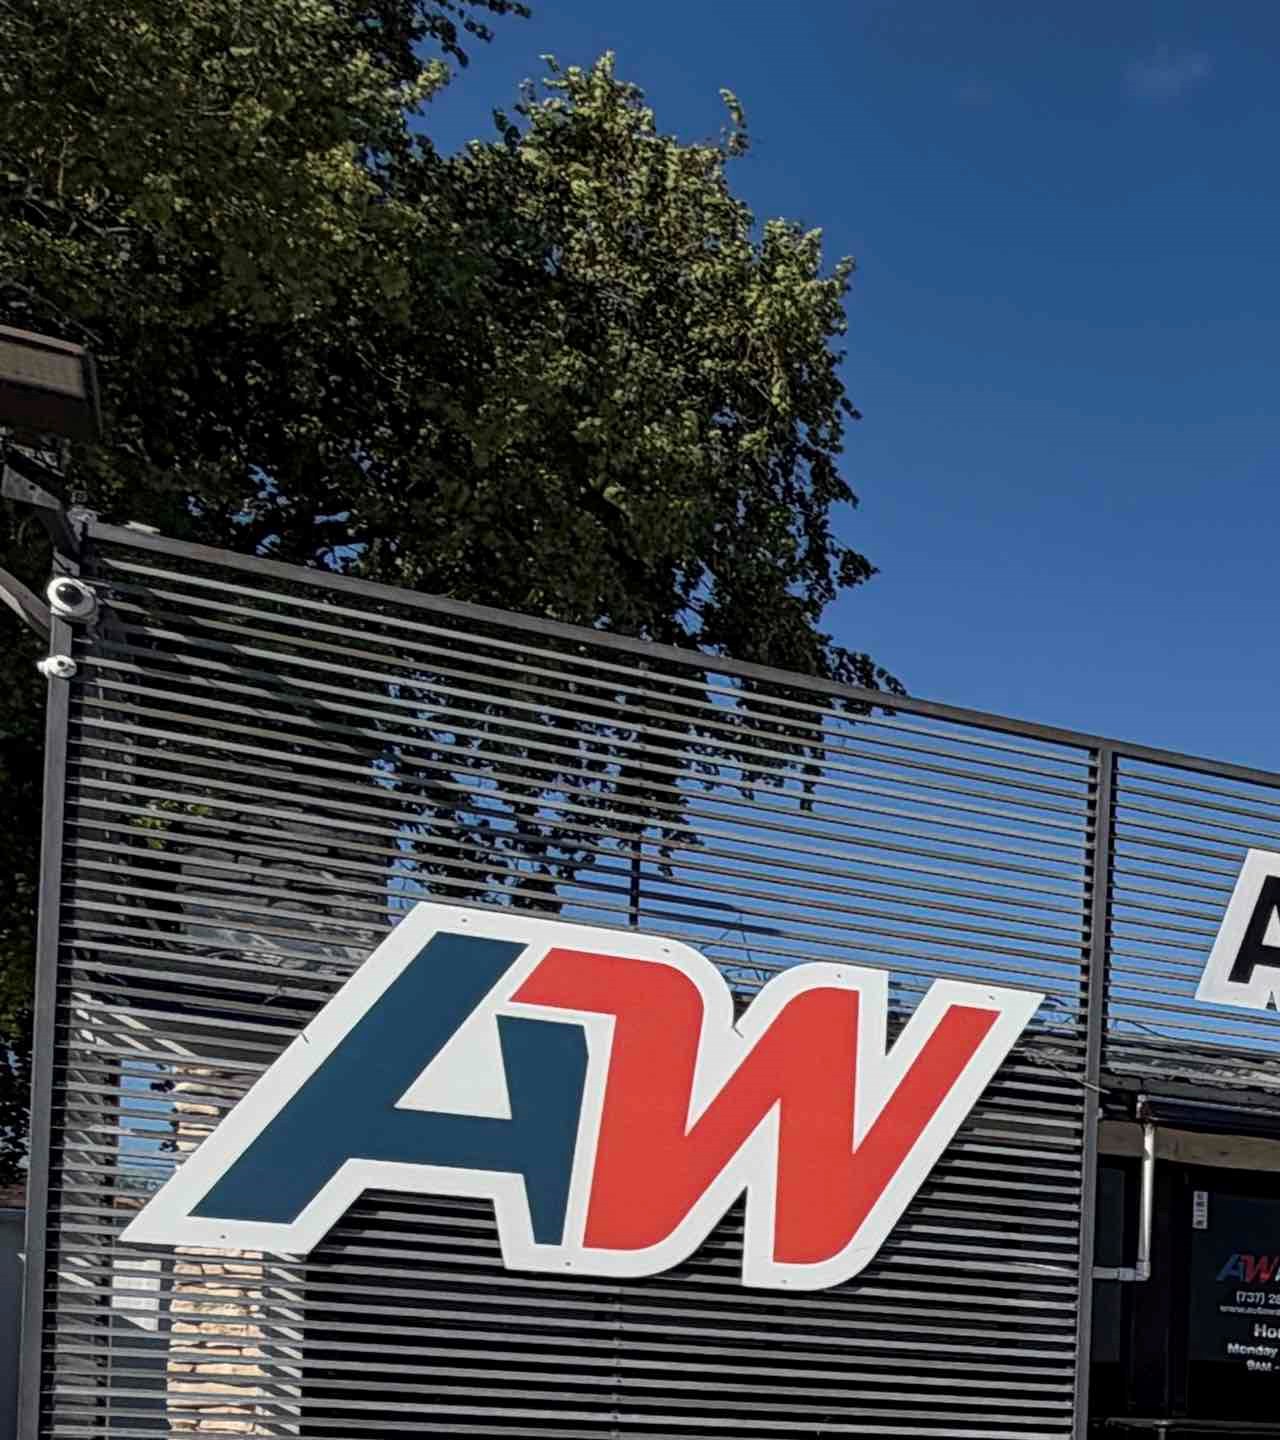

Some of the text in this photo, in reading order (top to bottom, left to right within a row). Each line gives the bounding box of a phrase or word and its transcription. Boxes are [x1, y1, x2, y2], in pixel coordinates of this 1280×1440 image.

[186, 931, 1003, 1265] AW
[1216, 1253, 1280, 1283] AW
[1236, 1291, 1266, 1305] (737)
[1227, 1343, 1278, 1359] Monday
